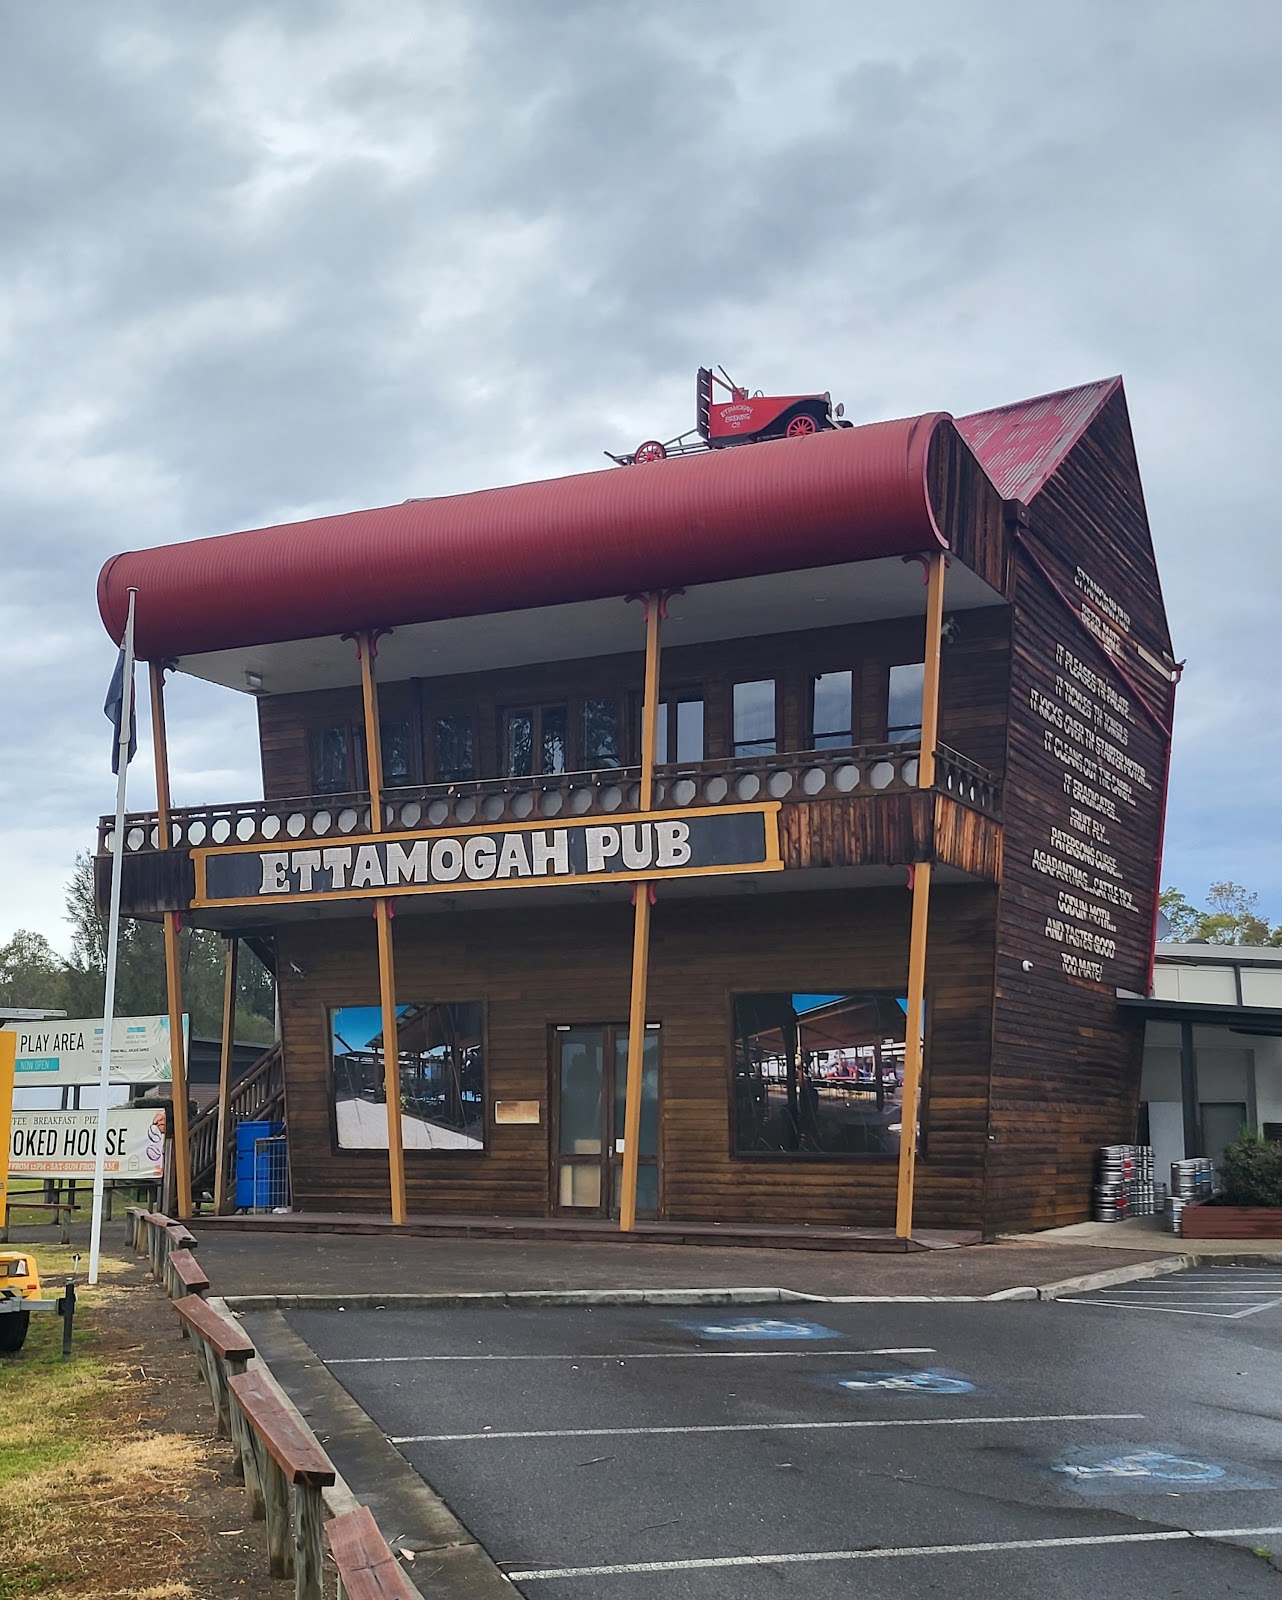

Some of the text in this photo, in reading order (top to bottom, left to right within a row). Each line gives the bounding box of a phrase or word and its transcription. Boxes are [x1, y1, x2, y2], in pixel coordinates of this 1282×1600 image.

[1055, 643, 1065, 666] IT
[1065, 651, 1097, 693] PLEASES
[1055, 675, 1064, 697] IT
[1030, 688, 1039, 711] IT
[1039, 695, 1064, 729] KICKS
[1064, 715, 1085, 745] OVER
[1095, 736, 1124, 772] STARTER
[1044, 730, 1053, 752] IT
[1053, 737, 1083, 773] CLEANS
[1083, 757, 1098, 782] OUT
[1063, 773, 1072, 795] IT
[1069, 806, 1092, 836] FRUIT
[258, 820, 692, 894] ETTAMOGAH PUB
[1045, 917, 1116, 959] AND TASTES GOOD
[1060, 952, 1079, 976] TOO
[20, 1034, 50, 1052] PLAY
[52, 1032, 85, 1051] AREA
[20, 1059, 50, 1070] NOW OPEN
[12, 1115, 99, 1125] FEE BREAKFAST PIZ
[9, 1129, 58, 1156] OKED
[12, 1162, 30, 1170] FROM
[50, 1162, 78, 1170] SAT-SUN
